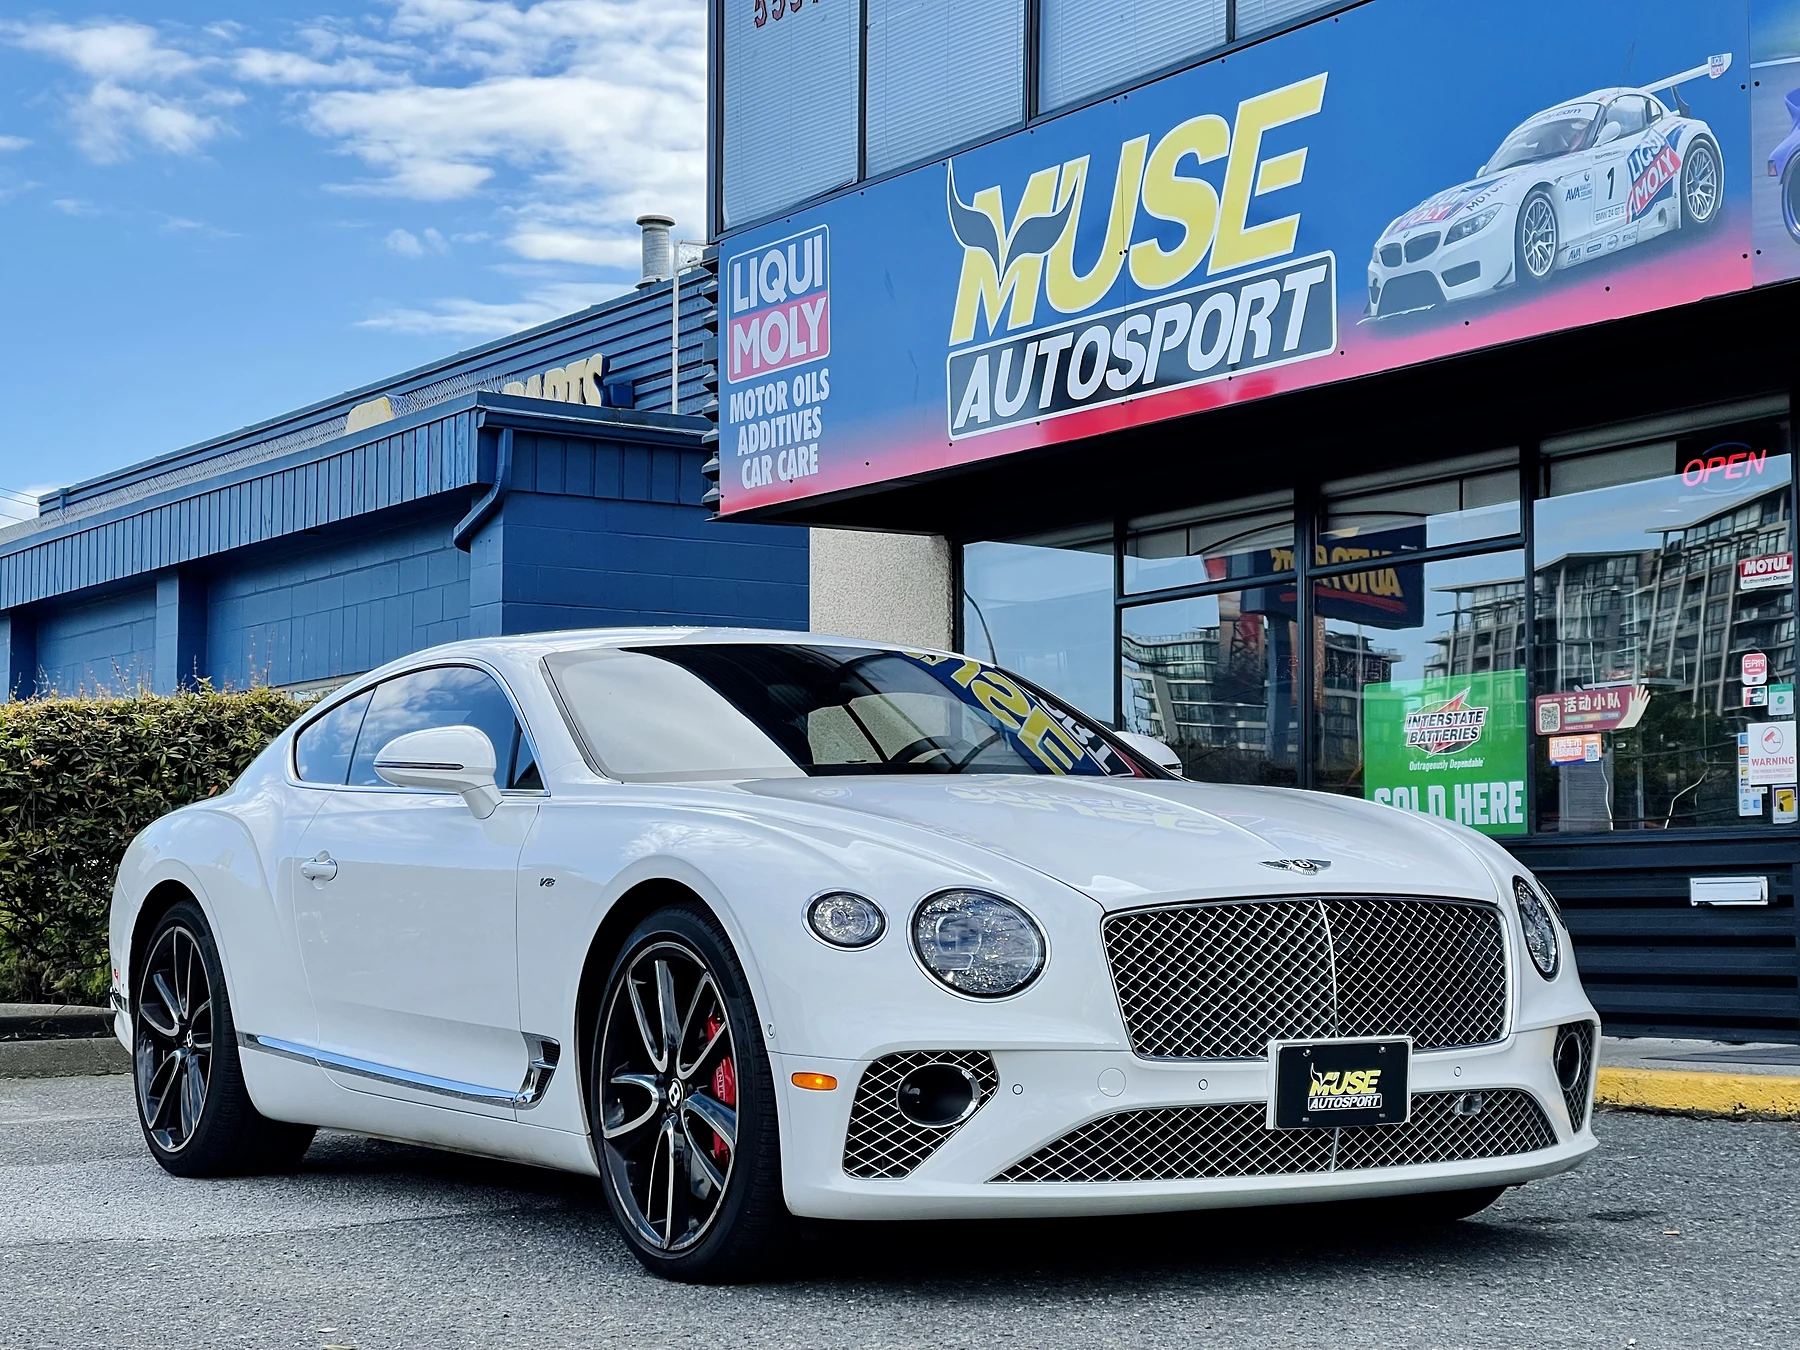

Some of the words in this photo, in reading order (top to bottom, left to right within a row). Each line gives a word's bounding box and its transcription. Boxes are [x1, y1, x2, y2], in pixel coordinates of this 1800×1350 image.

[1565, 186, 1580, 202] AVA
[1606, 166, 1615, 200] 1
[1635, 148, 1675, 211] MOLY
[947, 72, 1329, 347] MUSE
[733, 234, 823, 313] LIQUI
[733, 297, 827, 374] MOLY
[953, 264, 1328, 429] AUTOSPORT
[730, 380, 788, 424] MOTOR
[793, 368, 830, 407] OILS
[737, 406, 822, 456] ADDITIVES
[741, 454, 773, 489] CAR
[778, 443, 819, 481] CARE
[1682, 450, 1767, 487] OPEN
[1743, 556, 1790, 575] MOTUL
[1407, 710, 1484, 728] INTERSTATE
[1564, 692, 1621, 713] 活动小队
[1409, 727, 1479, 744] BATTERIES
[1409, 760, 1449, 772] Outrageously
[1751, 756, 1795, 766] WARNING
[1454, 781, 1524, 825] HERE
[1309, 1064, 1382, 1096] MUSE
[1310, 1095, 1381, 1109] AUTOSPORT
